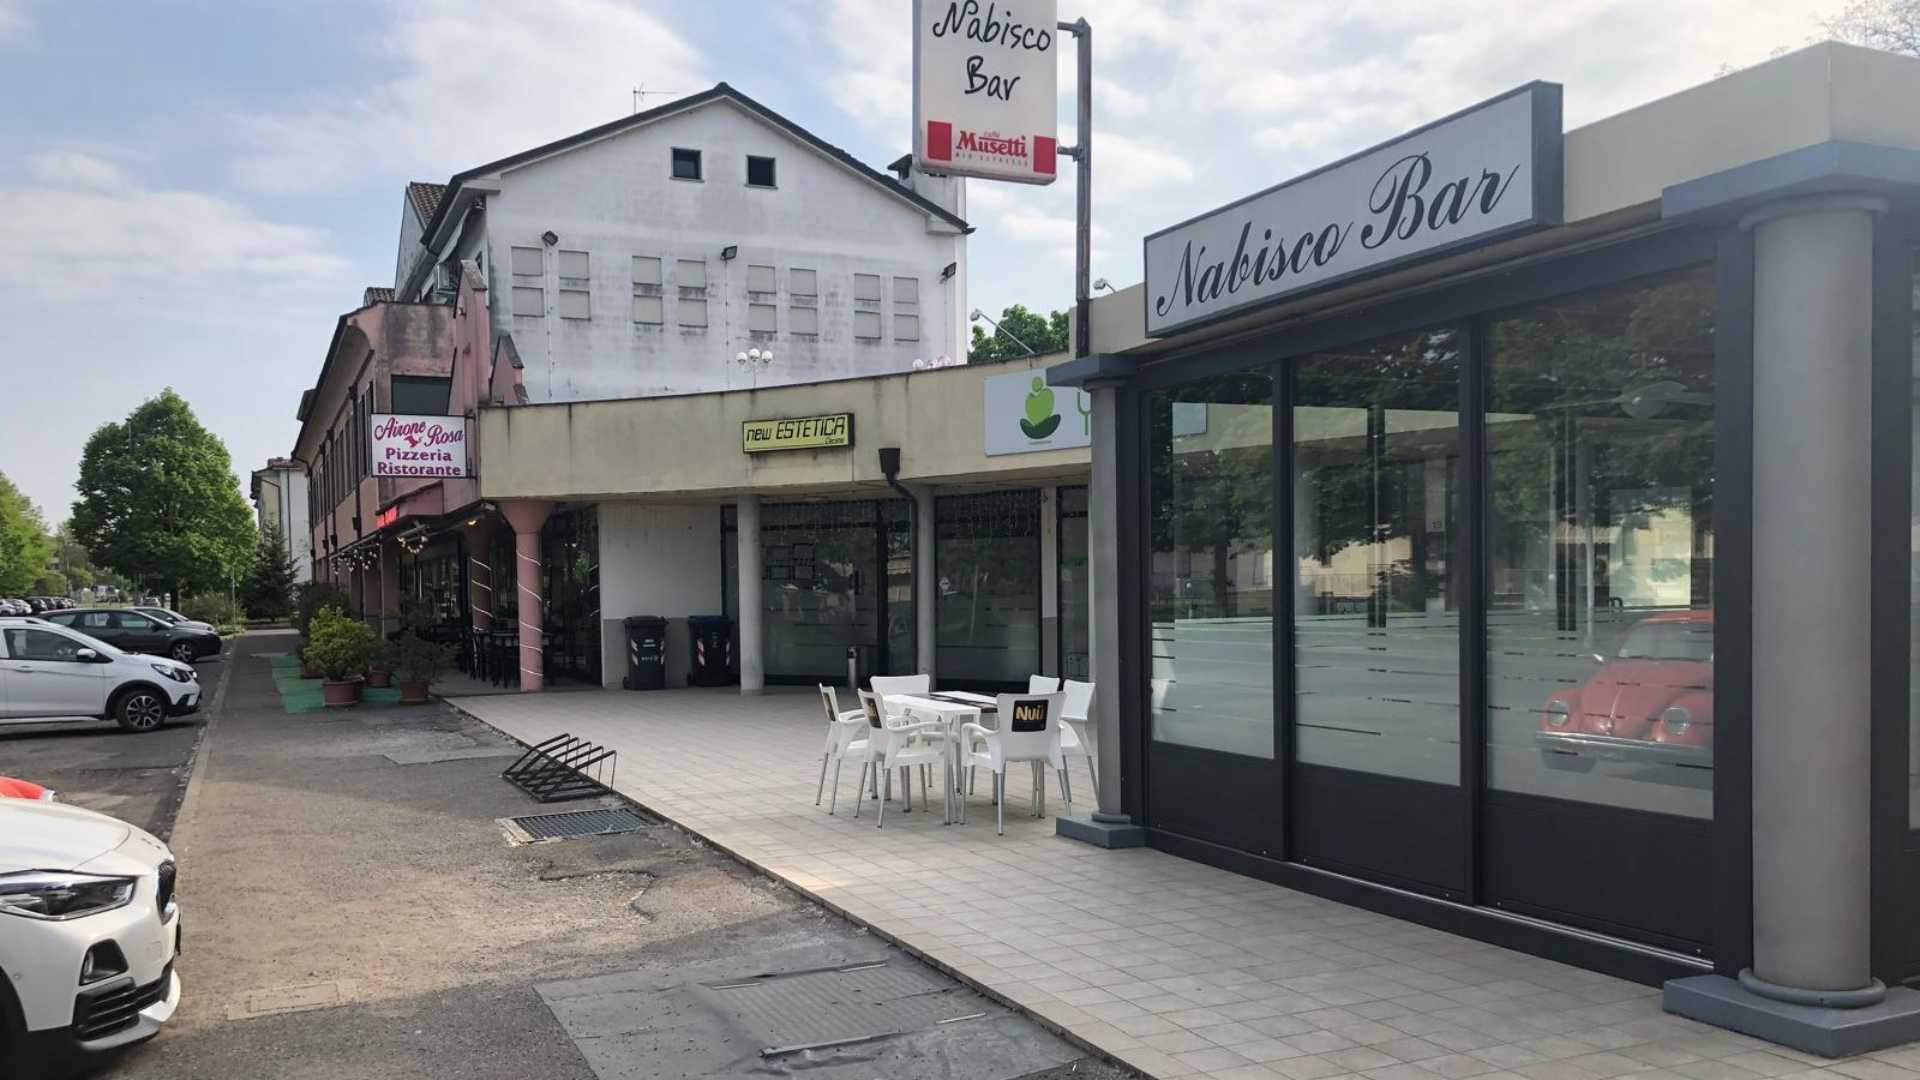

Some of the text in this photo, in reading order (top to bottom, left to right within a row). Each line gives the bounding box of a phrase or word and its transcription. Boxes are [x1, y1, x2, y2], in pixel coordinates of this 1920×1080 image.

[932, 0, 1051, 51] Nabisco
[964, 55, 1021, 101] Bar
[955, 130, 1028, 158] Musetti
[1156, 150, 1521, 317] Nabisco Bar
[374, 416, 464, 447] Airone Rosa
[775, 417, 846, 439] ESTETICA
[385, 447, 454, 461] Pizzeria
[377, 462, 462, 476] Ristorante
